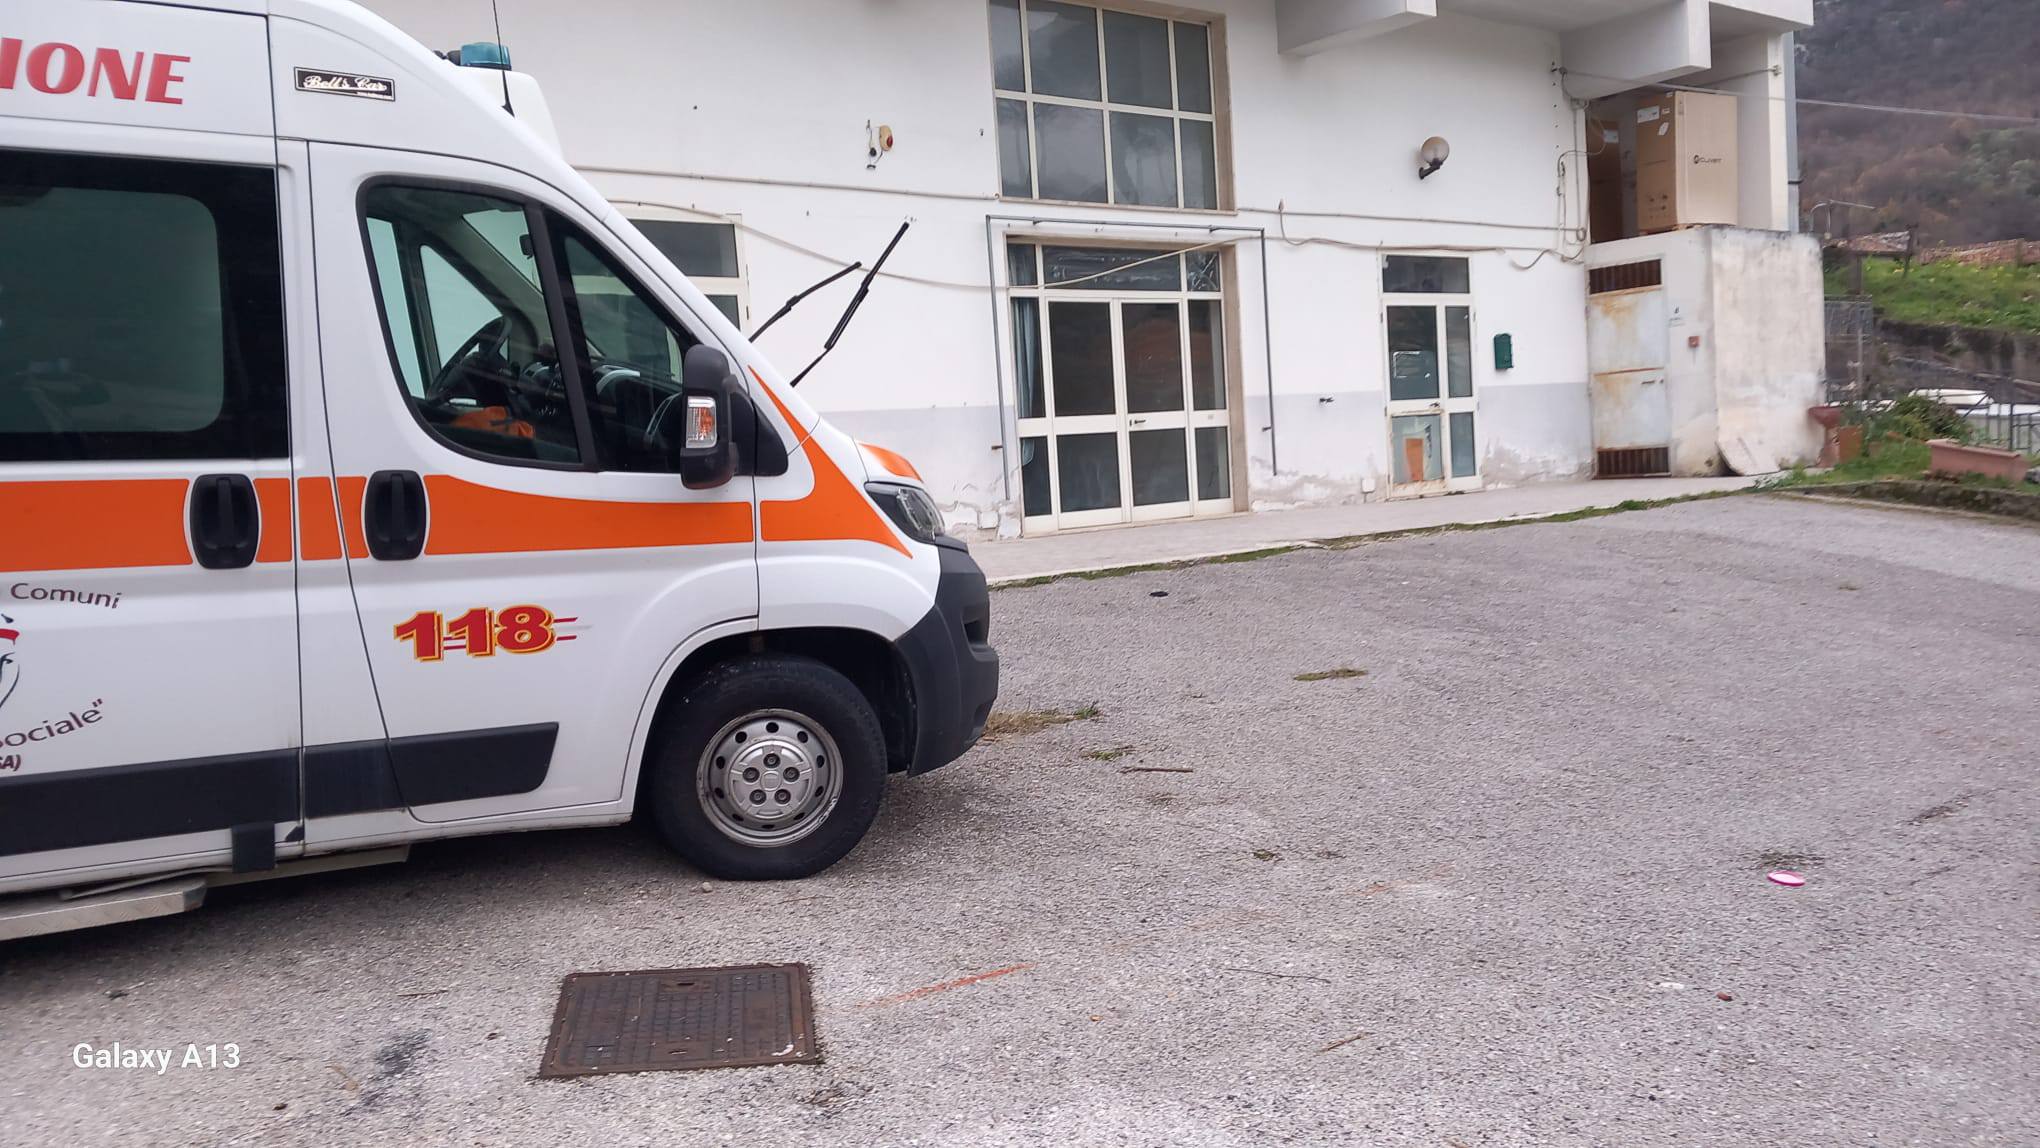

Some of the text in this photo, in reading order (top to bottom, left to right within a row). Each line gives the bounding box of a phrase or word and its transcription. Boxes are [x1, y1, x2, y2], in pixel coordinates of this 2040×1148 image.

[10, 583, 122, 609] Comuni
[393, 604, 557, 663] 118
[0, 698, 103, 749] ociale"
